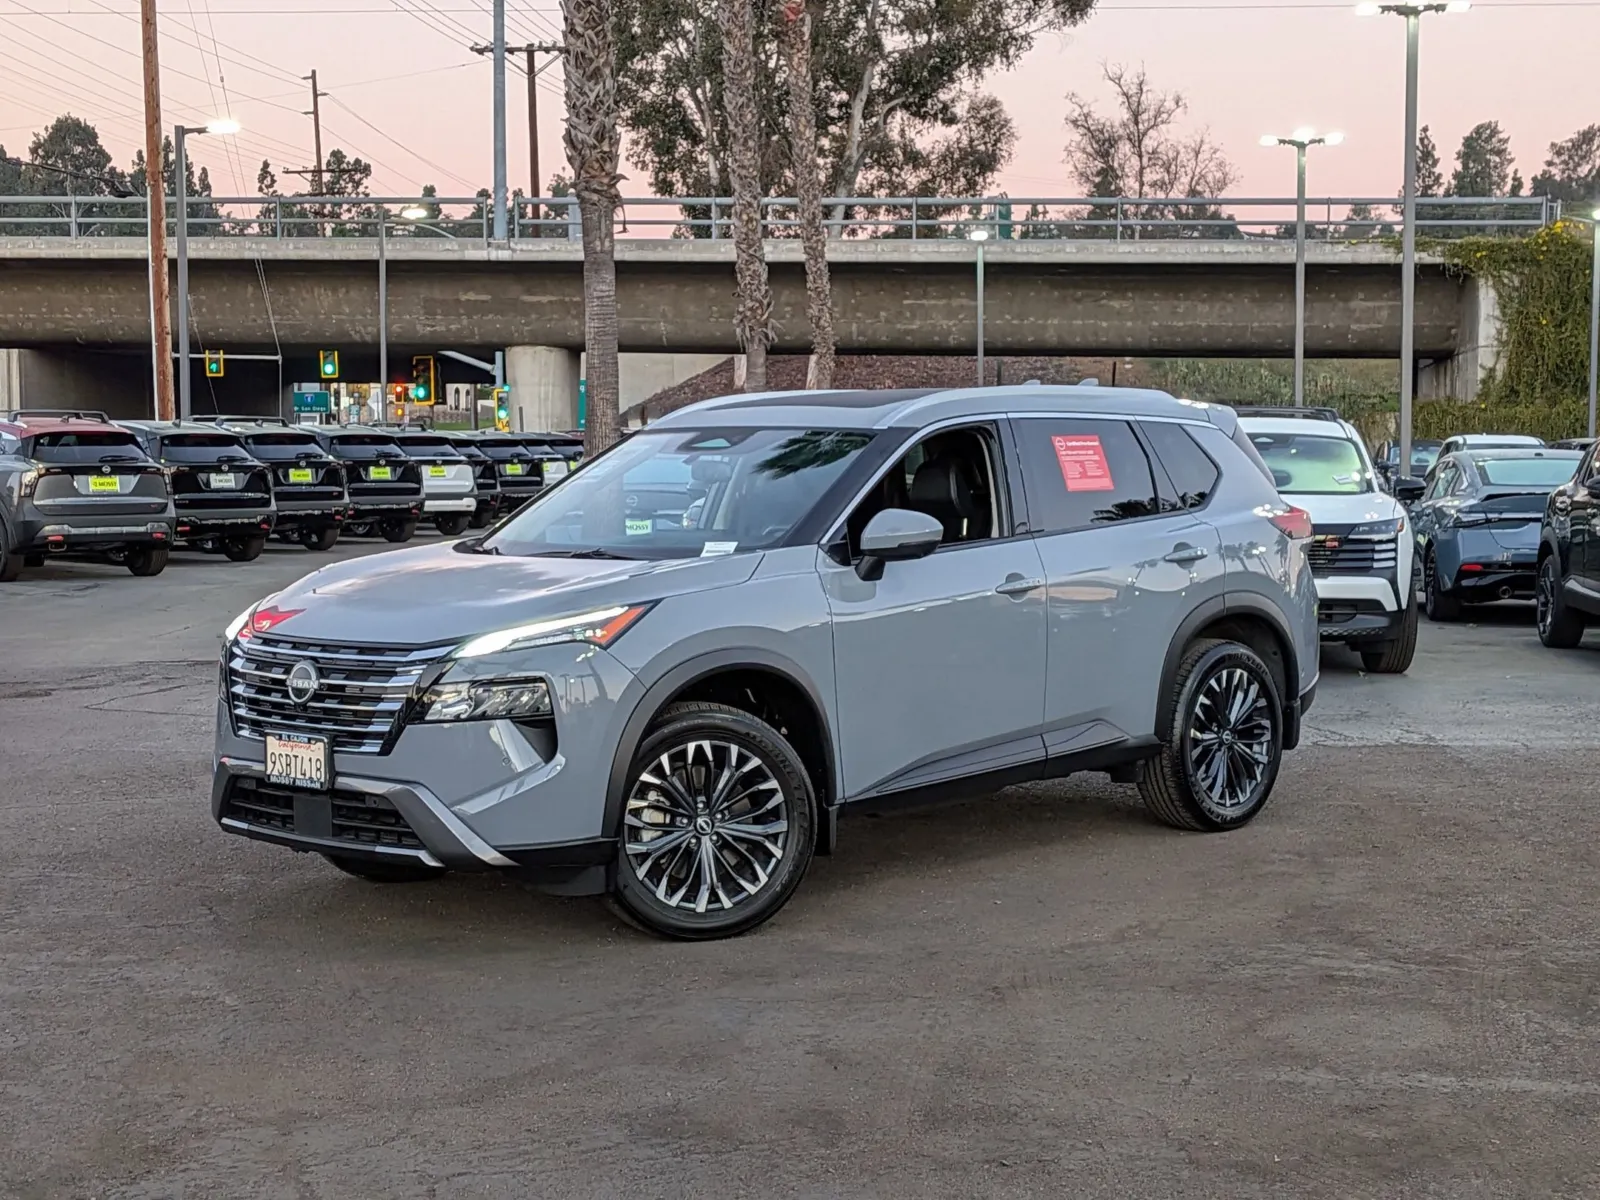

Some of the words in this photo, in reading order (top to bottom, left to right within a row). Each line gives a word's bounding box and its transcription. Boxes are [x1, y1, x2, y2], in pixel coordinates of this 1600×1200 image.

[290, 735, 309, 743] CAJON
[270, 752, 322, 781] 9SBT418
[270, 775, 293, 785] MOSSY
[295, 779, 321, 789] NISSAN
